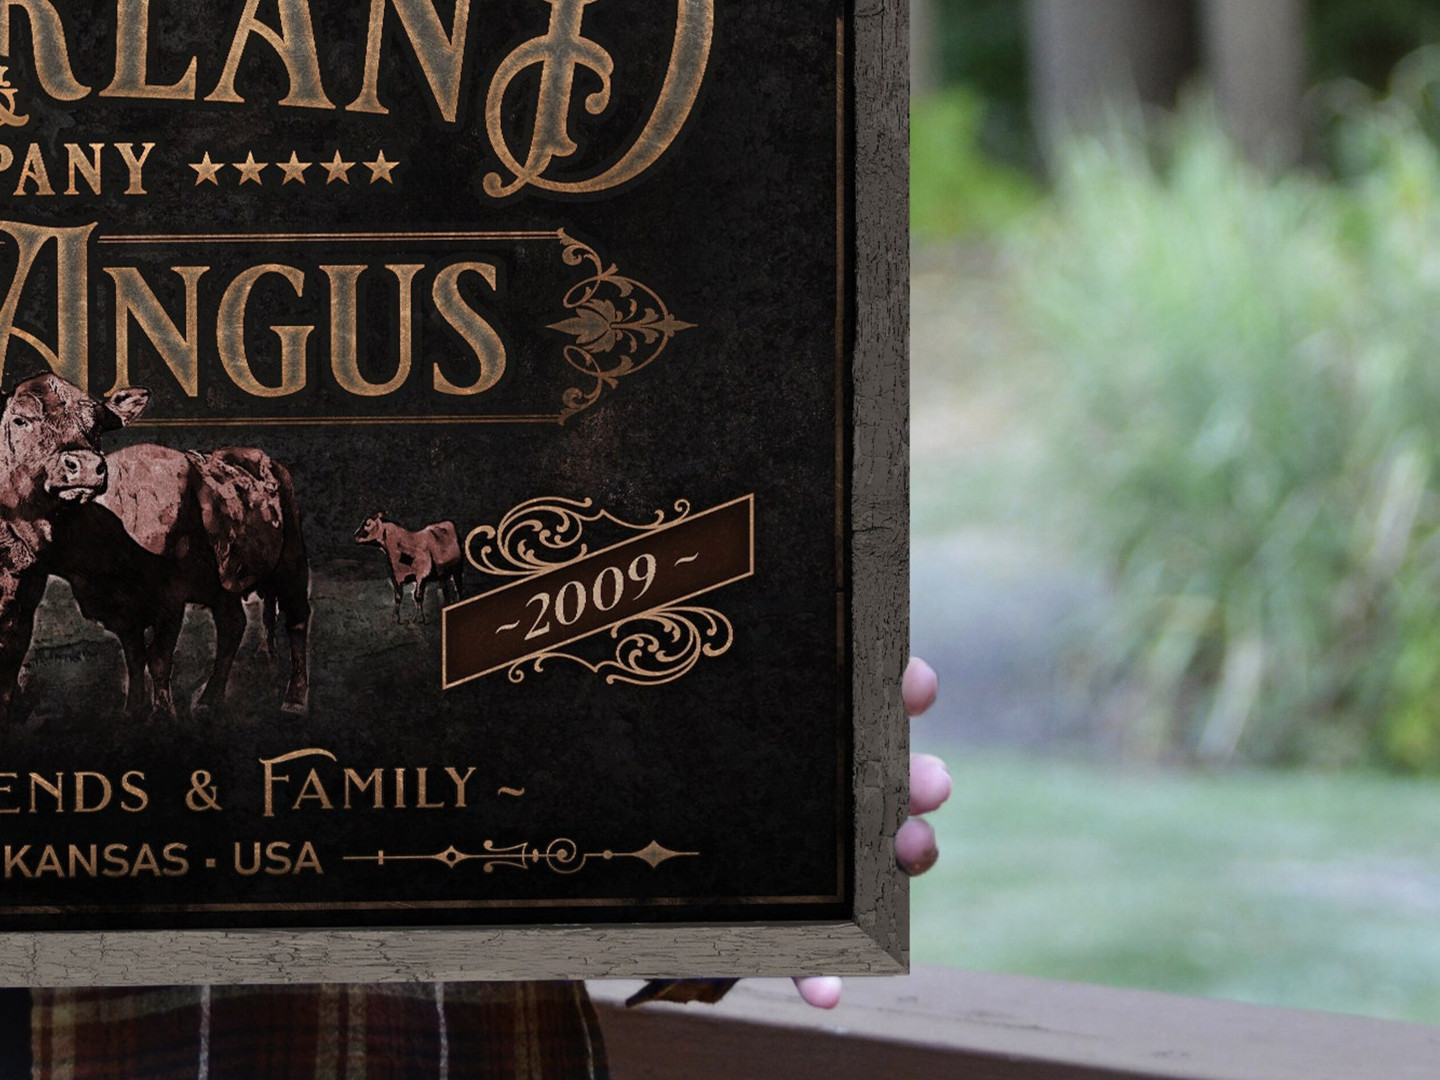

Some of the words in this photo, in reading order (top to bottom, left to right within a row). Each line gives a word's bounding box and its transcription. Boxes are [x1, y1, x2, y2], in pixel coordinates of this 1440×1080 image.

[185, 769, 222, 812] &
[258, 747, 478, 818] FAMILY
[4, 842, 190, 878] KANSAS
[233, 840, 324, 875] USA
